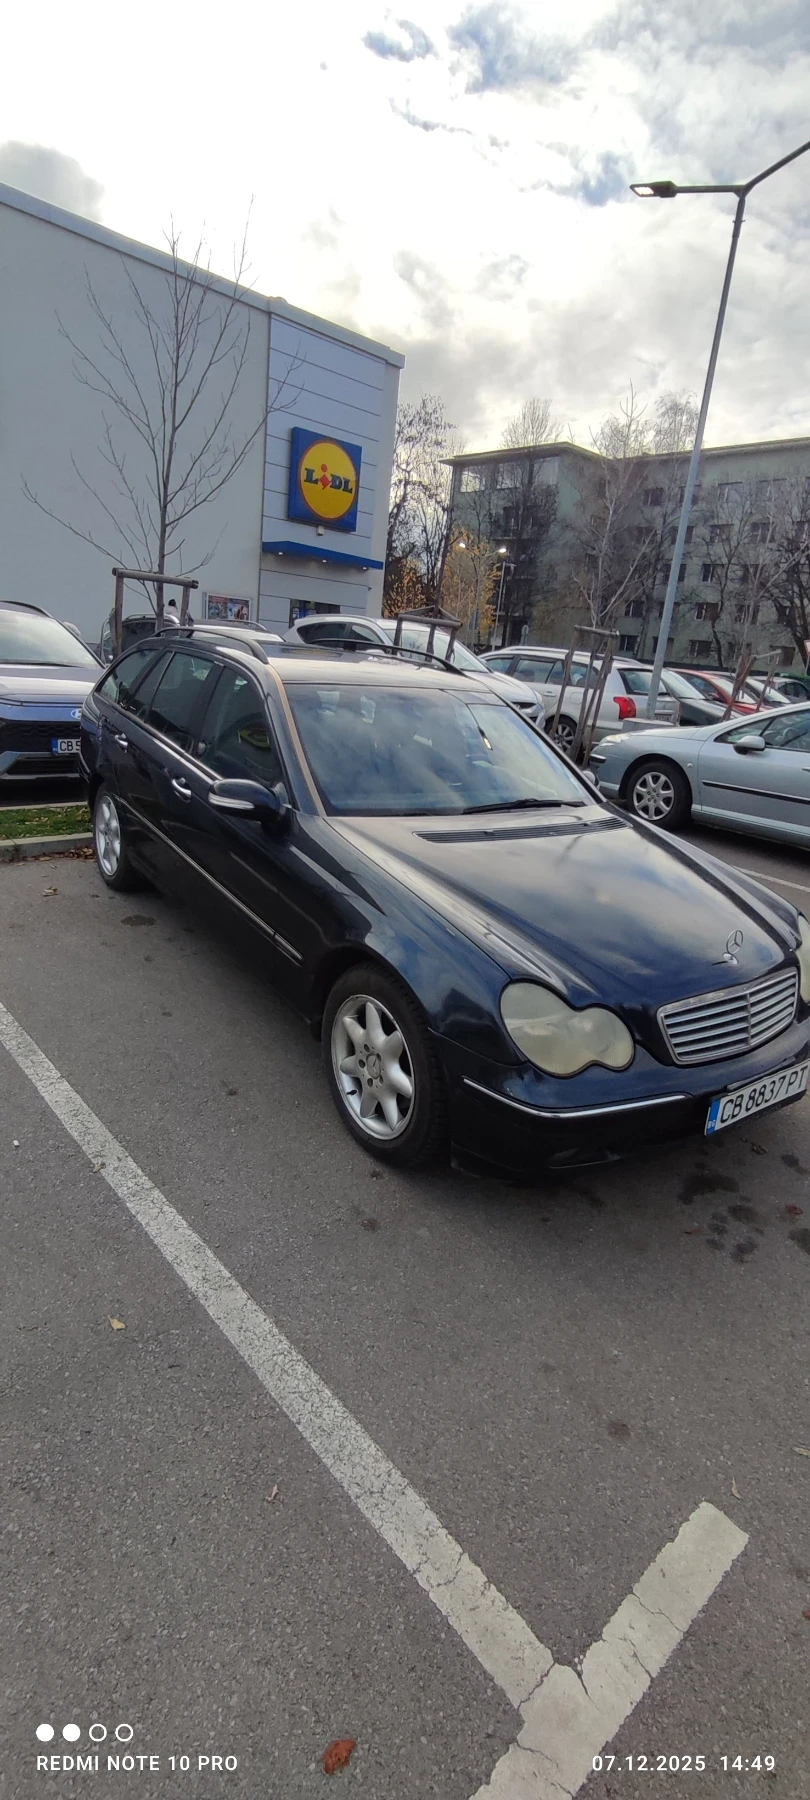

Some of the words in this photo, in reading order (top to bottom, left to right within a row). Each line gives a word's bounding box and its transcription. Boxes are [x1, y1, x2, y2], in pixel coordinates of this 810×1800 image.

[60, 741, 73, 751] CB
[720, 1094, 744, 1124] CB
[745, 1075, 787, 1112] 8837
[785, 1065, 808, 1094] PT
